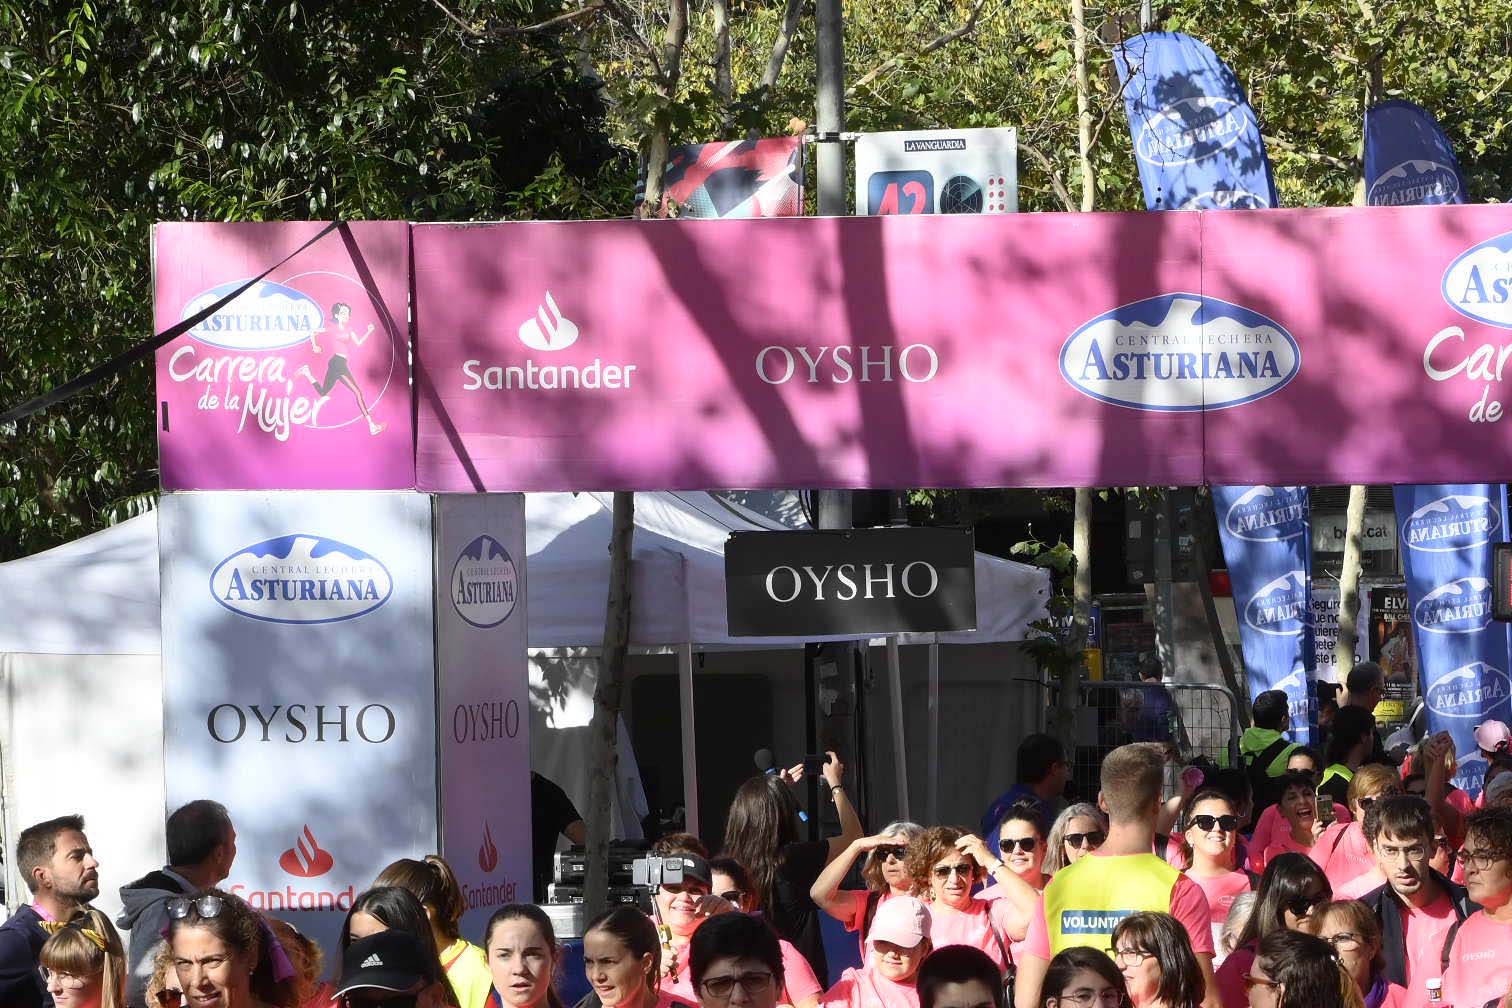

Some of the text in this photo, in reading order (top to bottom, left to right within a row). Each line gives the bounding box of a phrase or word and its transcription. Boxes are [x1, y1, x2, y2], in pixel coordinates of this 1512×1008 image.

[906, 140, 965, 151] LA VANGUARDIA
[168, 346, 286, 383] Carrera
[462, 359, 637, 391] Santander
[755, 343, 940, 385] OYSHO
[1079, 339, 1282, 380] ASTURIANA
[198, 381, 331, 442] de la Mujer
[1469, 384, 1504, 424] de
[225, 568, 381, 602] ASTURIANA
[456, 570, 514, 606] ASTURIANA
[765, 560, 939, 603] OYSHO
[206, 703, 397, 744] OYSHO
[453, 700, 520, 745] OYSHO
[460, 880, 518, 912] Santander
